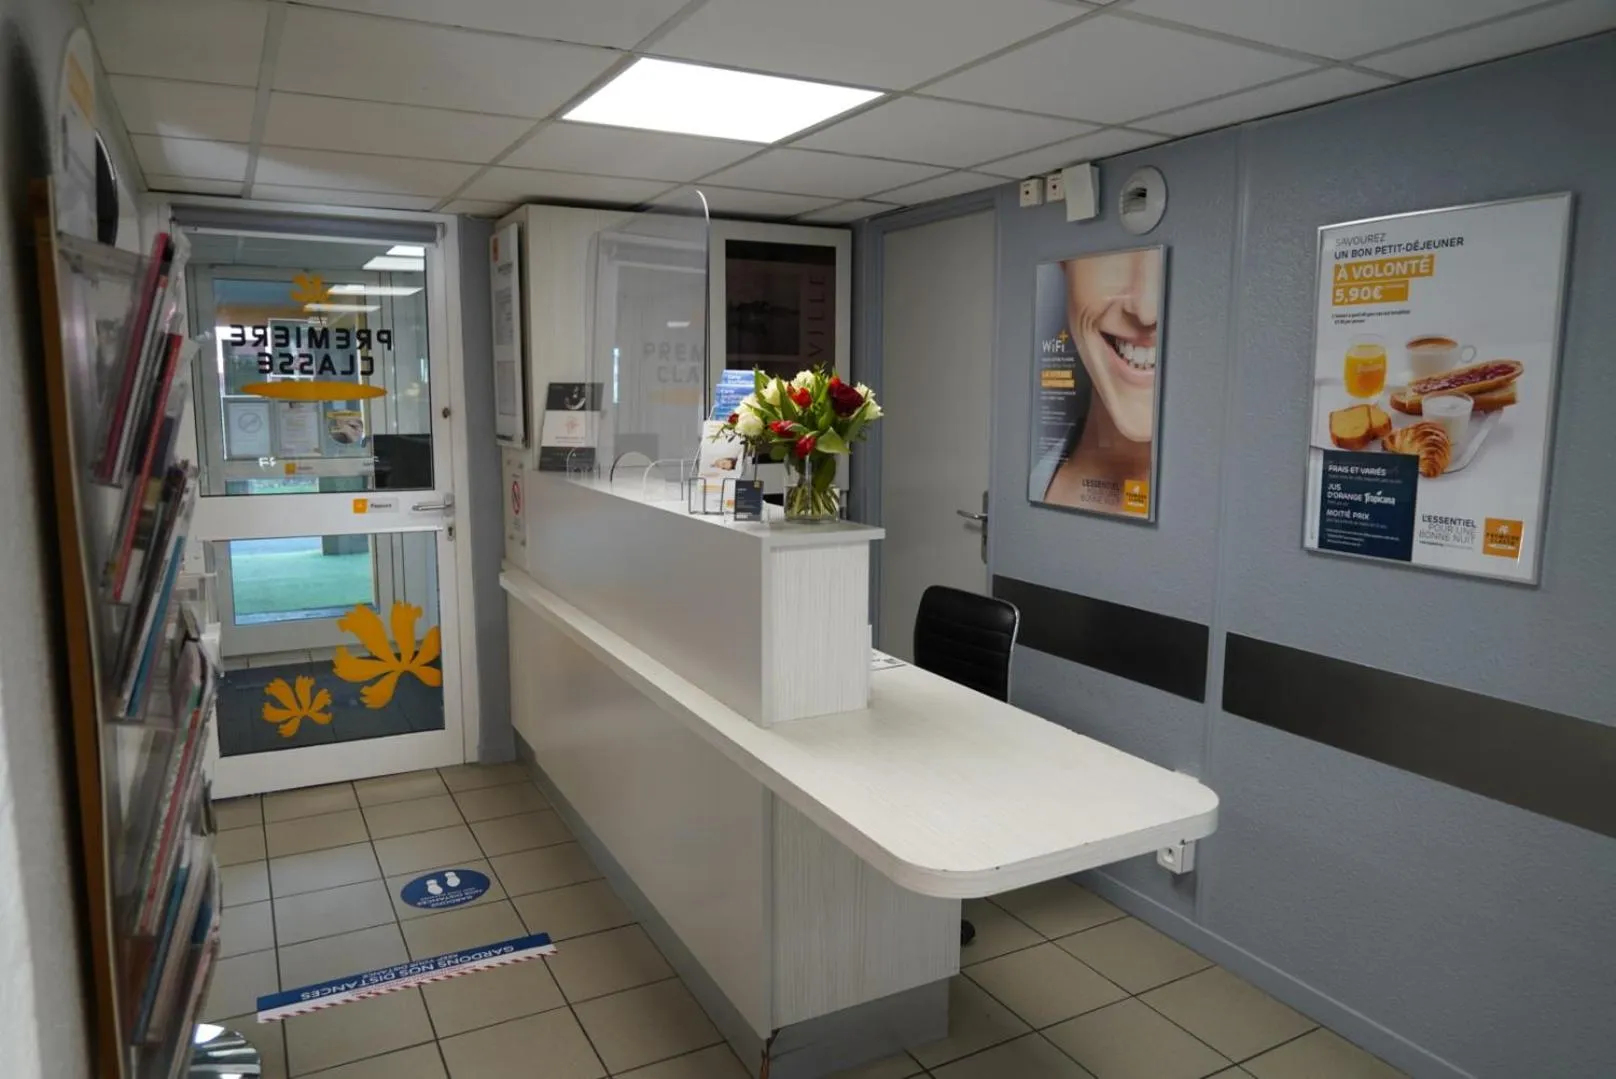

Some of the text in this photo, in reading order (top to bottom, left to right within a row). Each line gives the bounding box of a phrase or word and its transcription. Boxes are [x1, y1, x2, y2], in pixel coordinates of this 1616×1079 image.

[1334, 236, 1465, 261] UN BON PETIT-DÉJEUNER
[1335, 232, 1387, 247] SAVOUREZ
[1351, 256, 1431, 280] VOLONTÉ
[1334, 285, 1383, 304] 5,90€
[1327, 483, 1342, 491] JUS
[1422, 513, 1476, 528] L'ESSENTIEL
[438, 945, 514, 967] GARDONS
[399, 964, 434, 977] NOS
[301, 971, 396, 1000] DISTANCES
